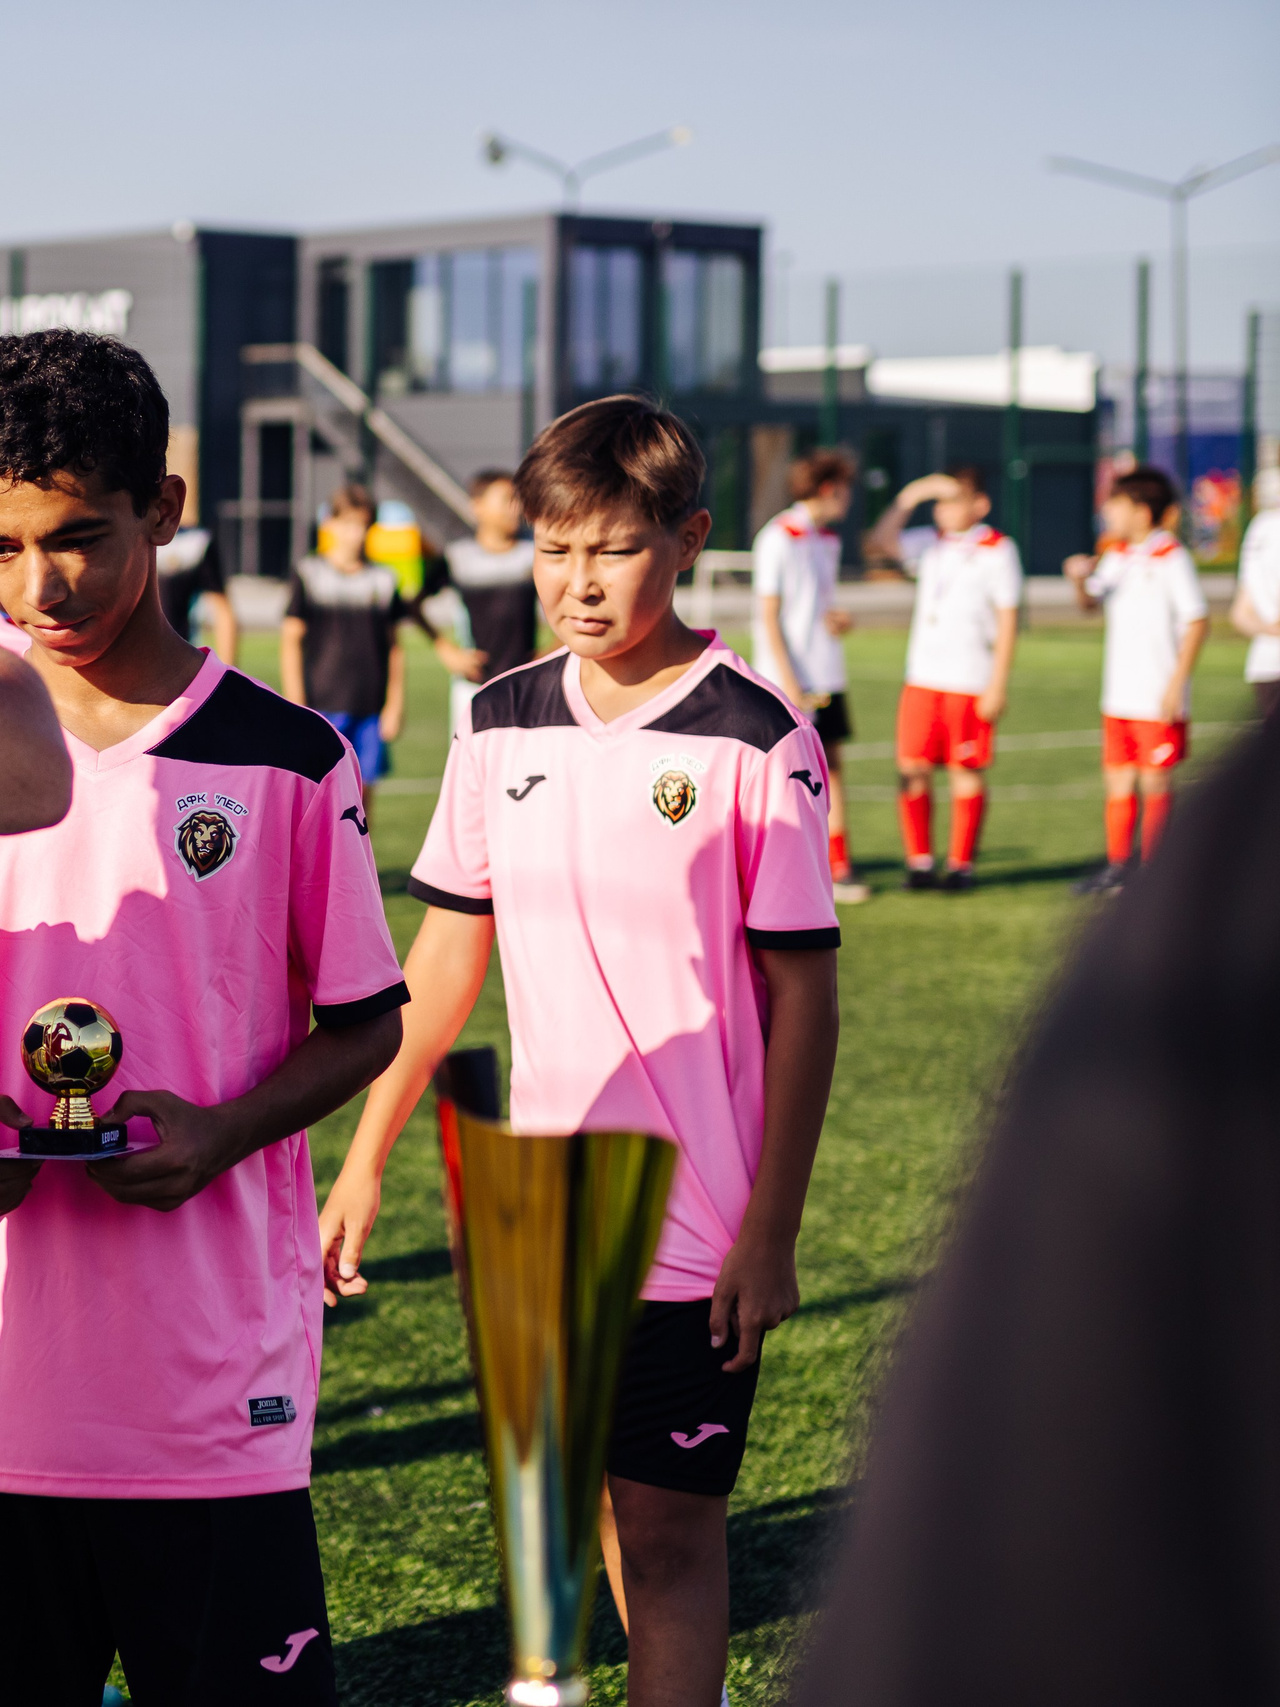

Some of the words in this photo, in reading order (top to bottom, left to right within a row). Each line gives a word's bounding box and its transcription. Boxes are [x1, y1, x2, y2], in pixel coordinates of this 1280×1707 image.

[177, 793, 207, 811] ДФК
[215, 794, 248, 815] "ЛЕО"
[101, 1131, 110, 1144] LEO
[110, 1129, 120, 1141] CUP
[253, 1416, 262, 1424] ALL
[262, 1415, 272, 1423] FOR
[272, 1413, 285, 1422] SPORT
